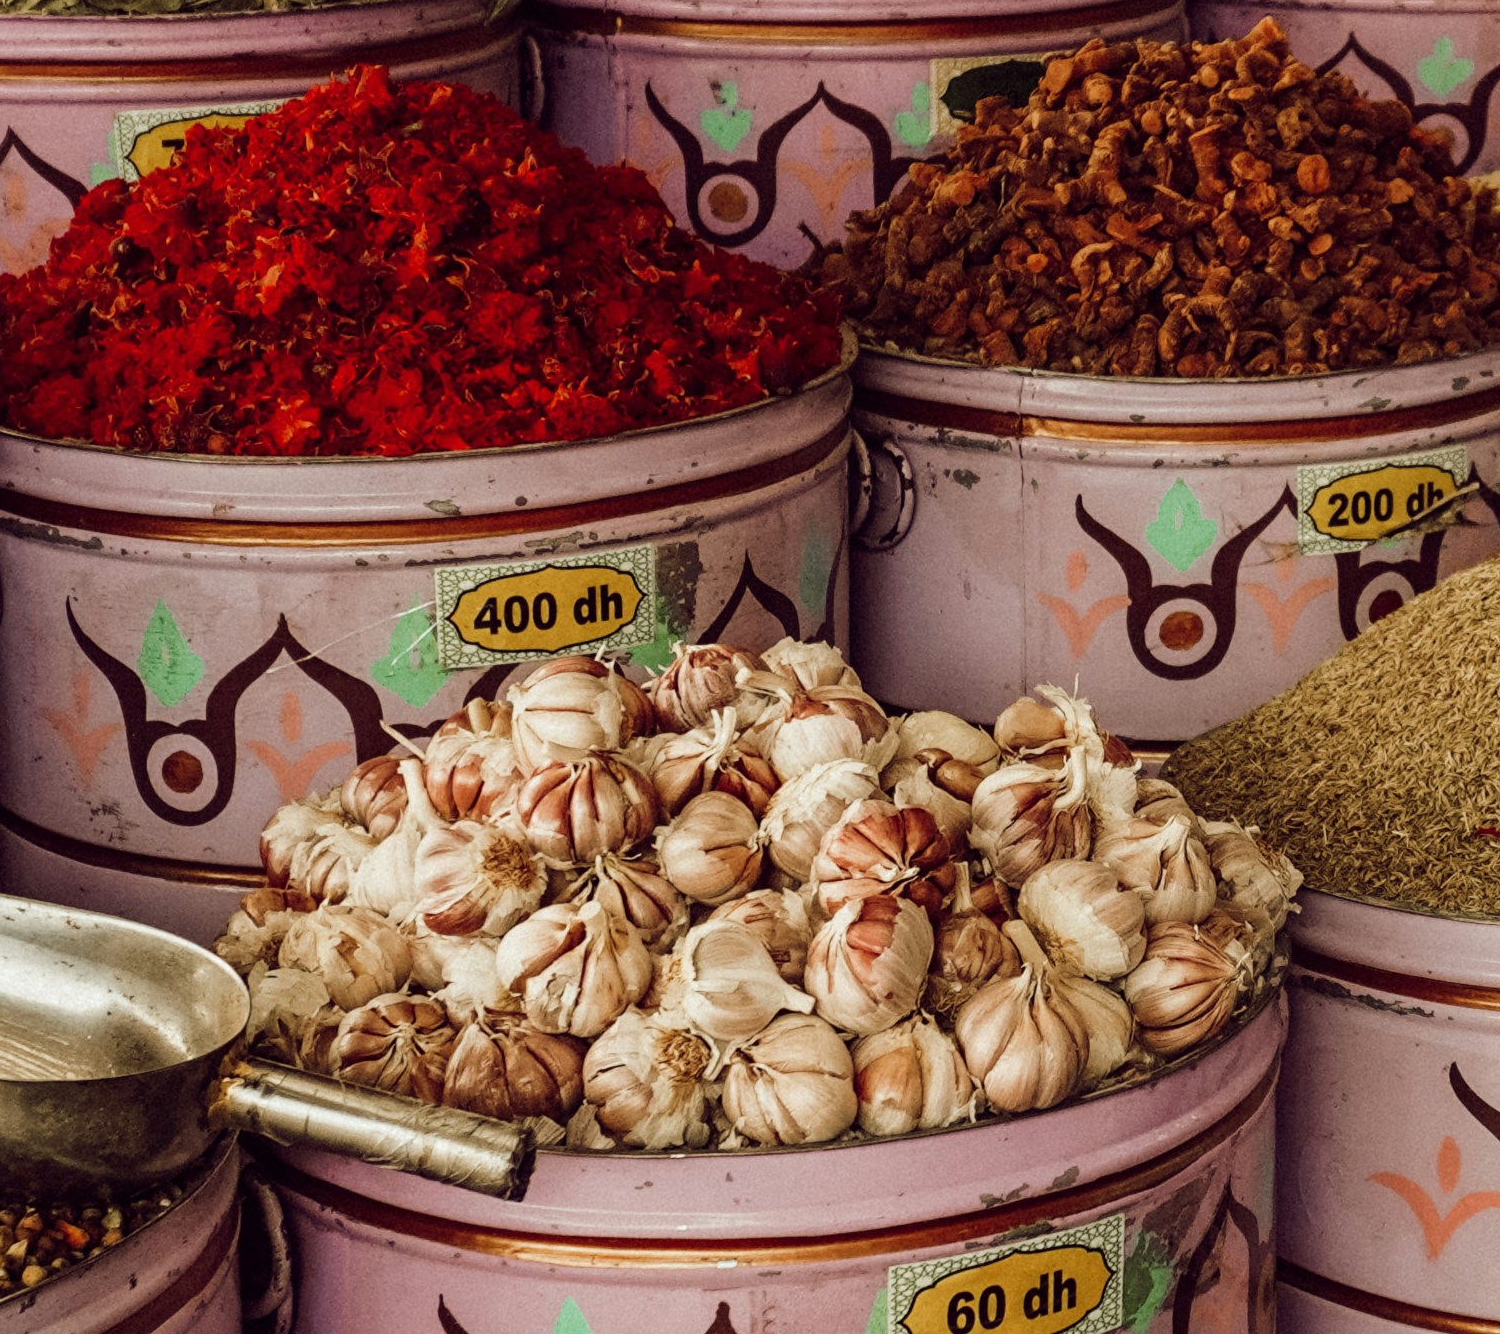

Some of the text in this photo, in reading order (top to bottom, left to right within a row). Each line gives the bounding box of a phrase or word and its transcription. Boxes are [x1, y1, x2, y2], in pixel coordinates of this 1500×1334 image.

[1327, 481, 1444, 528] 200 dh
[473, 584, 624, 635] 400 dh
[1023, 1269, 1077, 1320] dh
